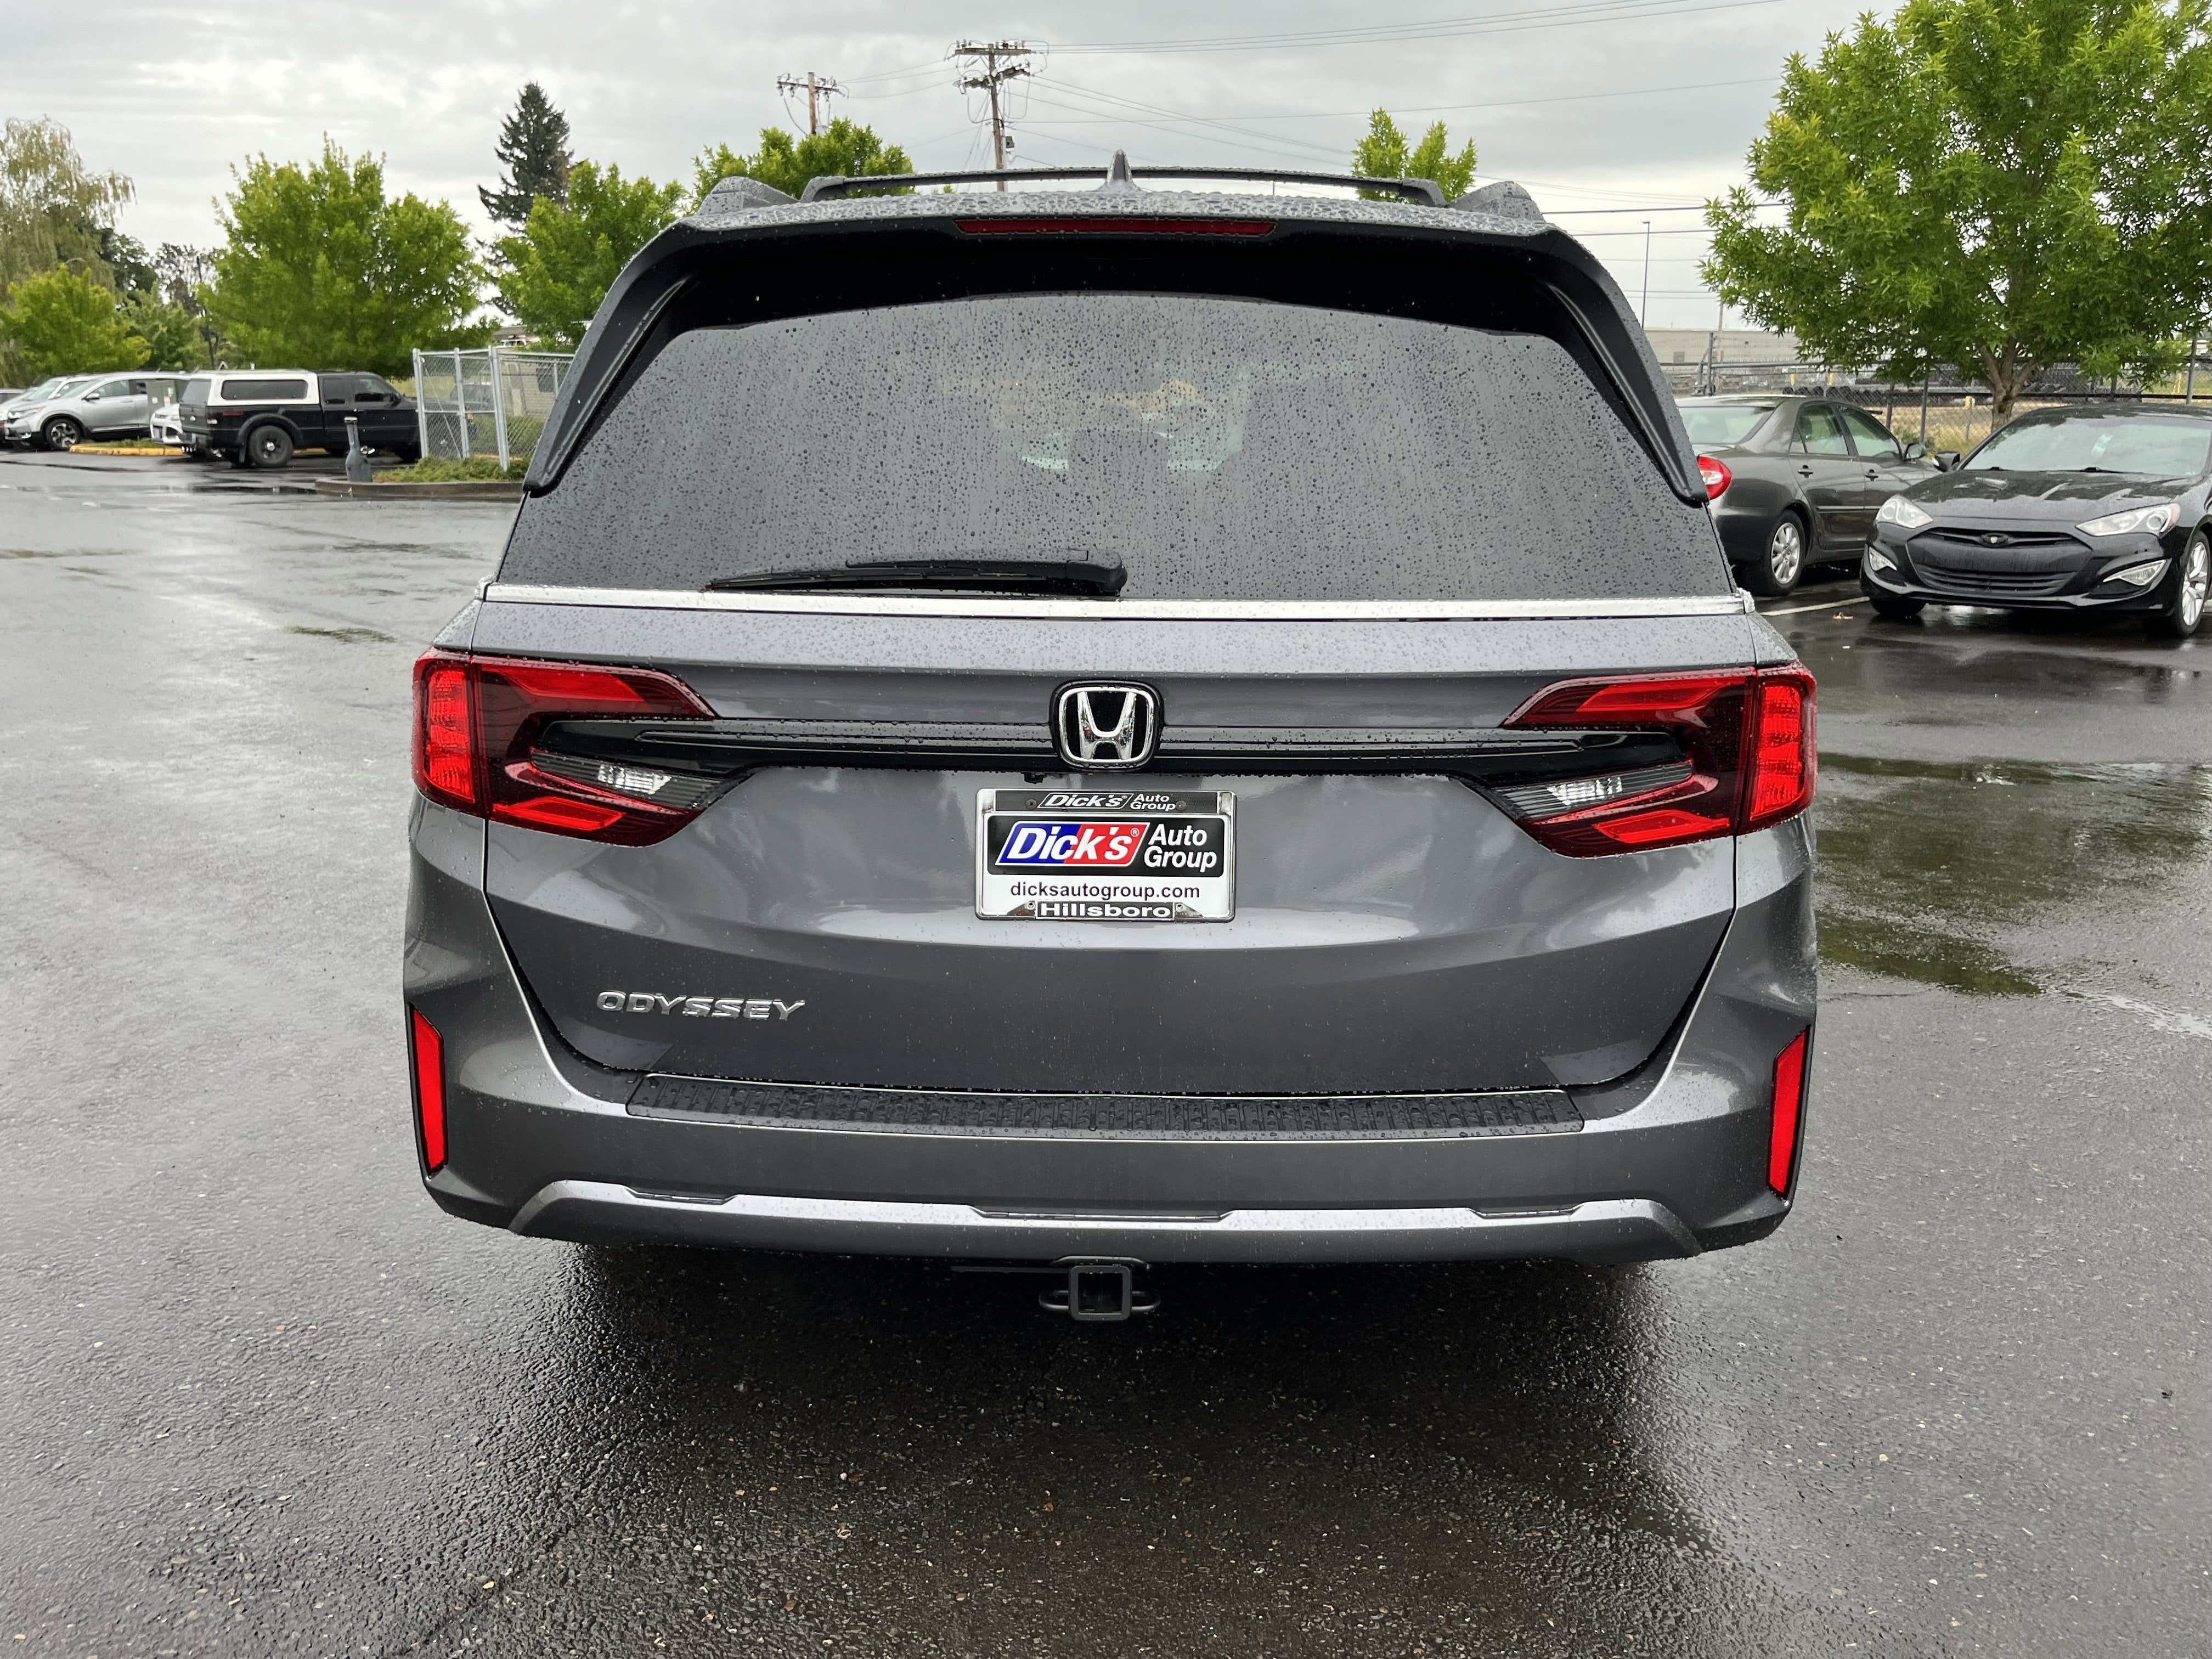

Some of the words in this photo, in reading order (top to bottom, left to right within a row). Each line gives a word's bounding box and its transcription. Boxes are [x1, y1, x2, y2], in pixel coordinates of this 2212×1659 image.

[1044, 794, 1123, 807] Dick's
[1130, 802, 1176, 812] Group
[1133, 793, 1170, 802] Auto
[1007, 826, 1133, 860] Dick's
[1148, 823, 1207, 847] Auto
[1144, 846, 1217, 873] Group
[1010, 882, 1200, 901] dicksautogroup.com
[1040, 902, 1171, 918] Hillsboro
[596, 990, 805, 1020] ODYSSEY
